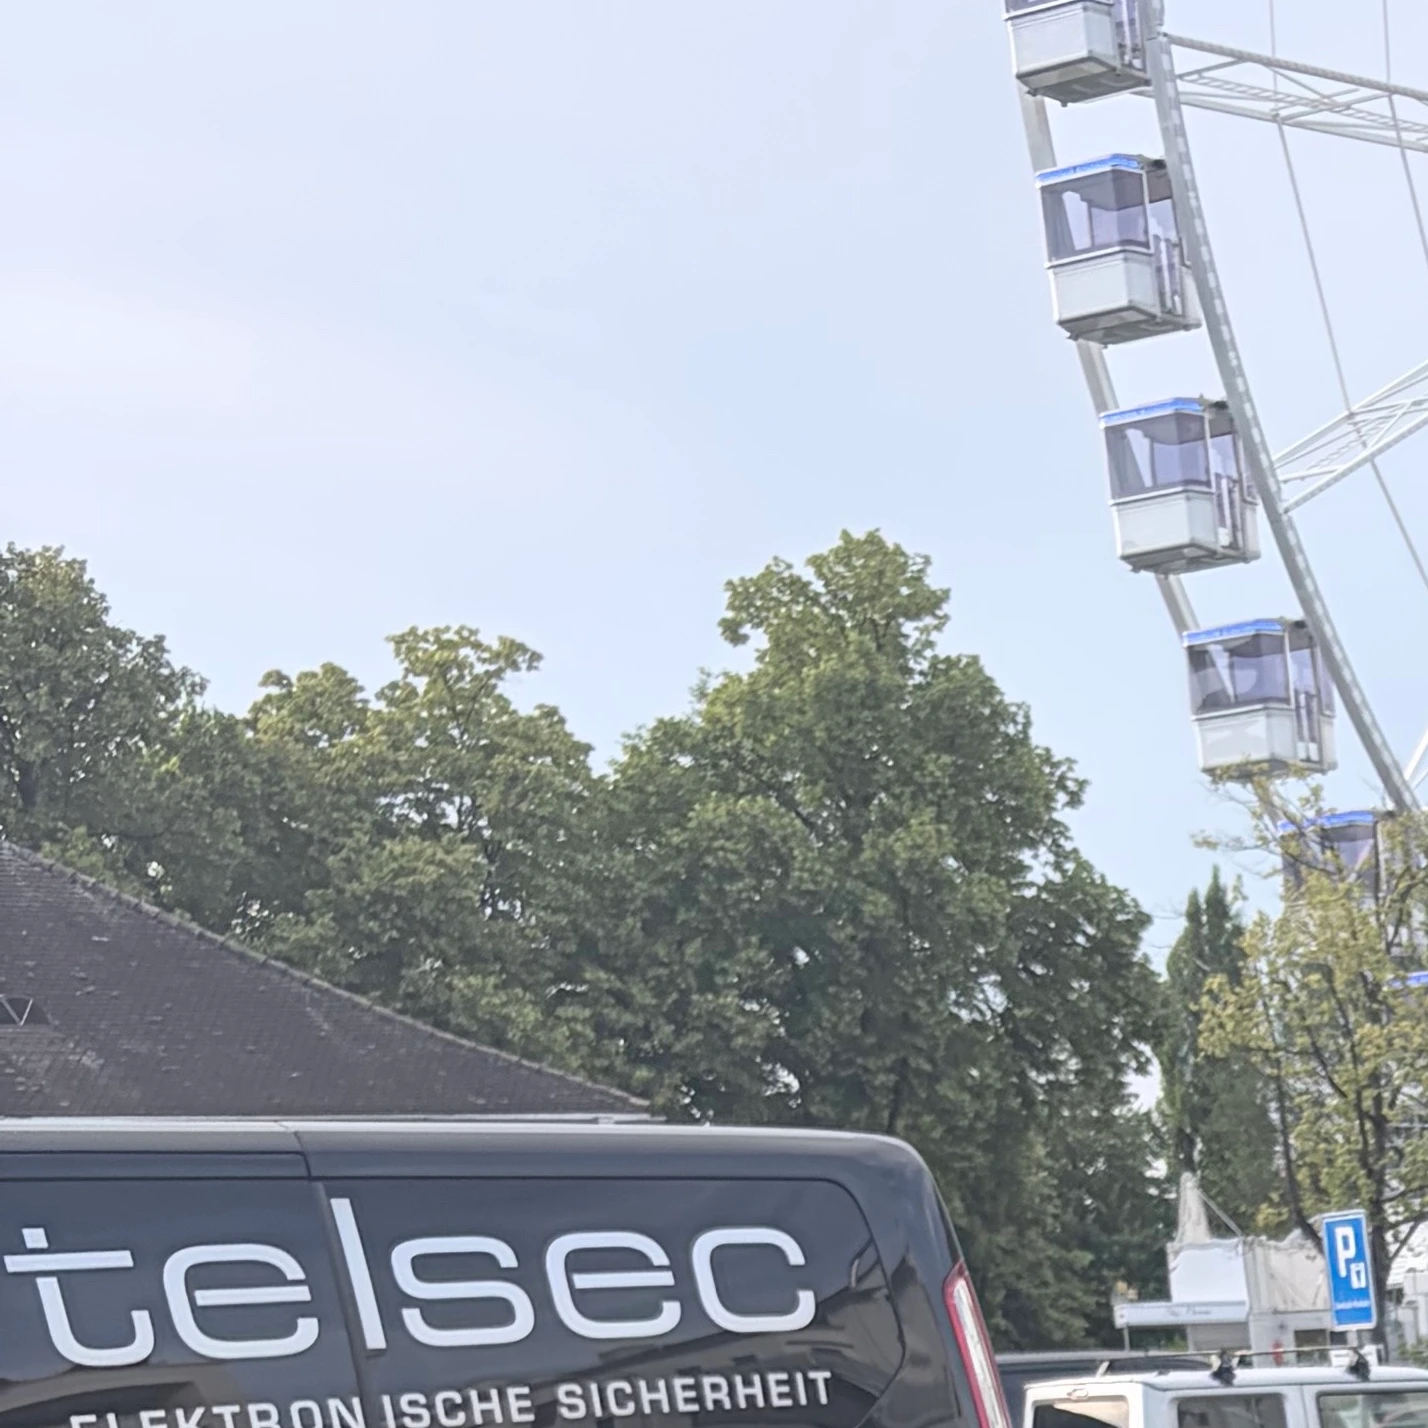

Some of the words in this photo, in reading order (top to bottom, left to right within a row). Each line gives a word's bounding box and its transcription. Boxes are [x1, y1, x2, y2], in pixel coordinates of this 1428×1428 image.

[1334, 1226, 1356, 1278] P
[3, 1198, 815, 1367] telsec
[556, 1370, 832, 1420] SICHERHEIT
